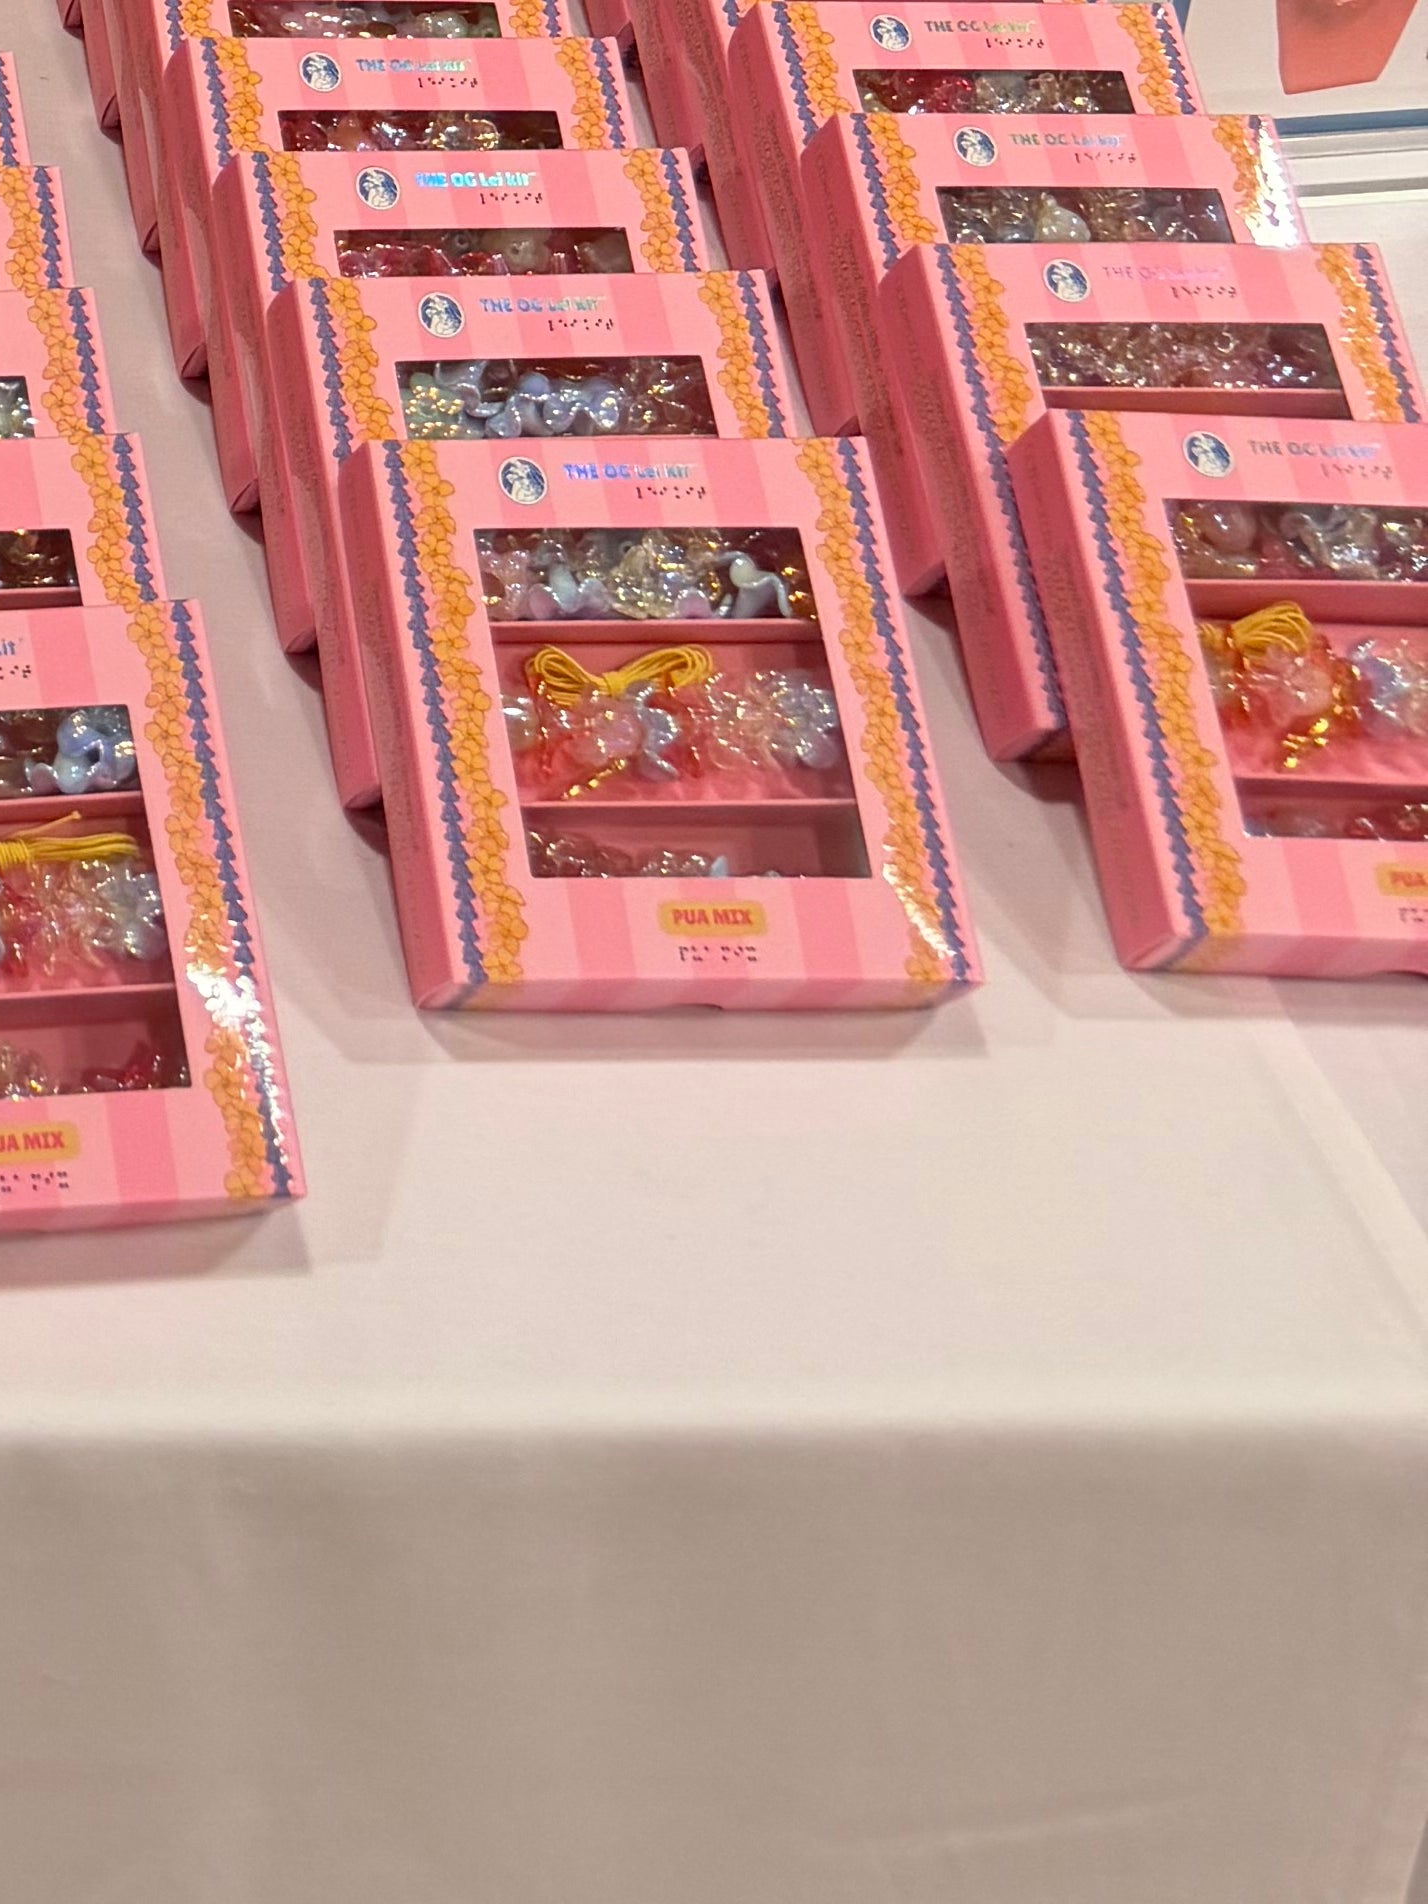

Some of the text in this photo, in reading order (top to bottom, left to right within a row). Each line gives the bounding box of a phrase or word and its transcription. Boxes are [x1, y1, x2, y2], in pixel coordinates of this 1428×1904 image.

[673, 908, 751, 926] PUA MIX
[24, 1131, 64, 1150] MIX
